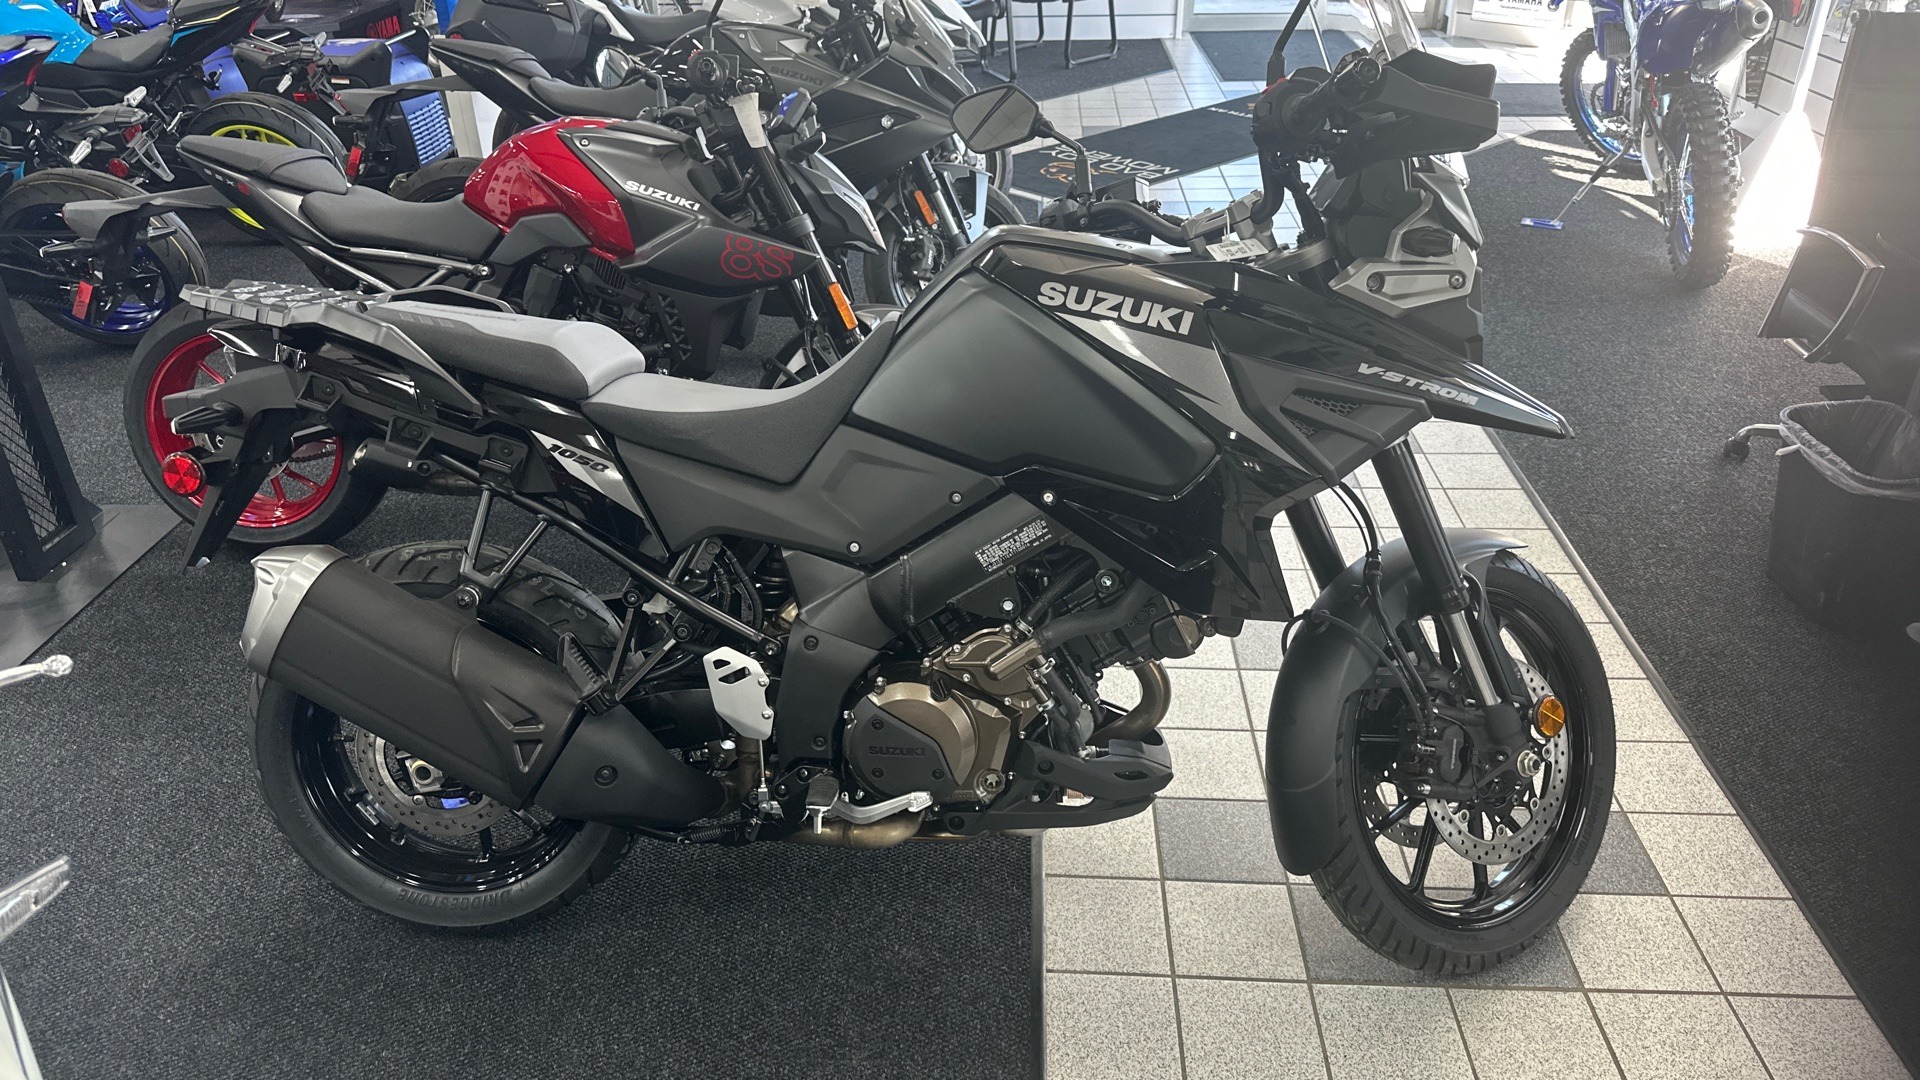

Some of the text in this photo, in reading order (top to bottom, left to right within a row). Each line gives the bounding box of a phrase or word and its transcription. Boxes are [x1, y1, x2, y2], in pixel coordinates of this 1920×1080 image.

[769, 65, 824, 87] SUZUKI
[1099, 162, 1164, 179] BAD
[624, 180, 701, 211] SUZUKI
[1037, 281, 1195, 336] SUZUKI
[1358, 362, 1480, 406] V-STROM
[546, 443, 610, 473] 1050
[867, 745, 926, 756] SUZUKI
